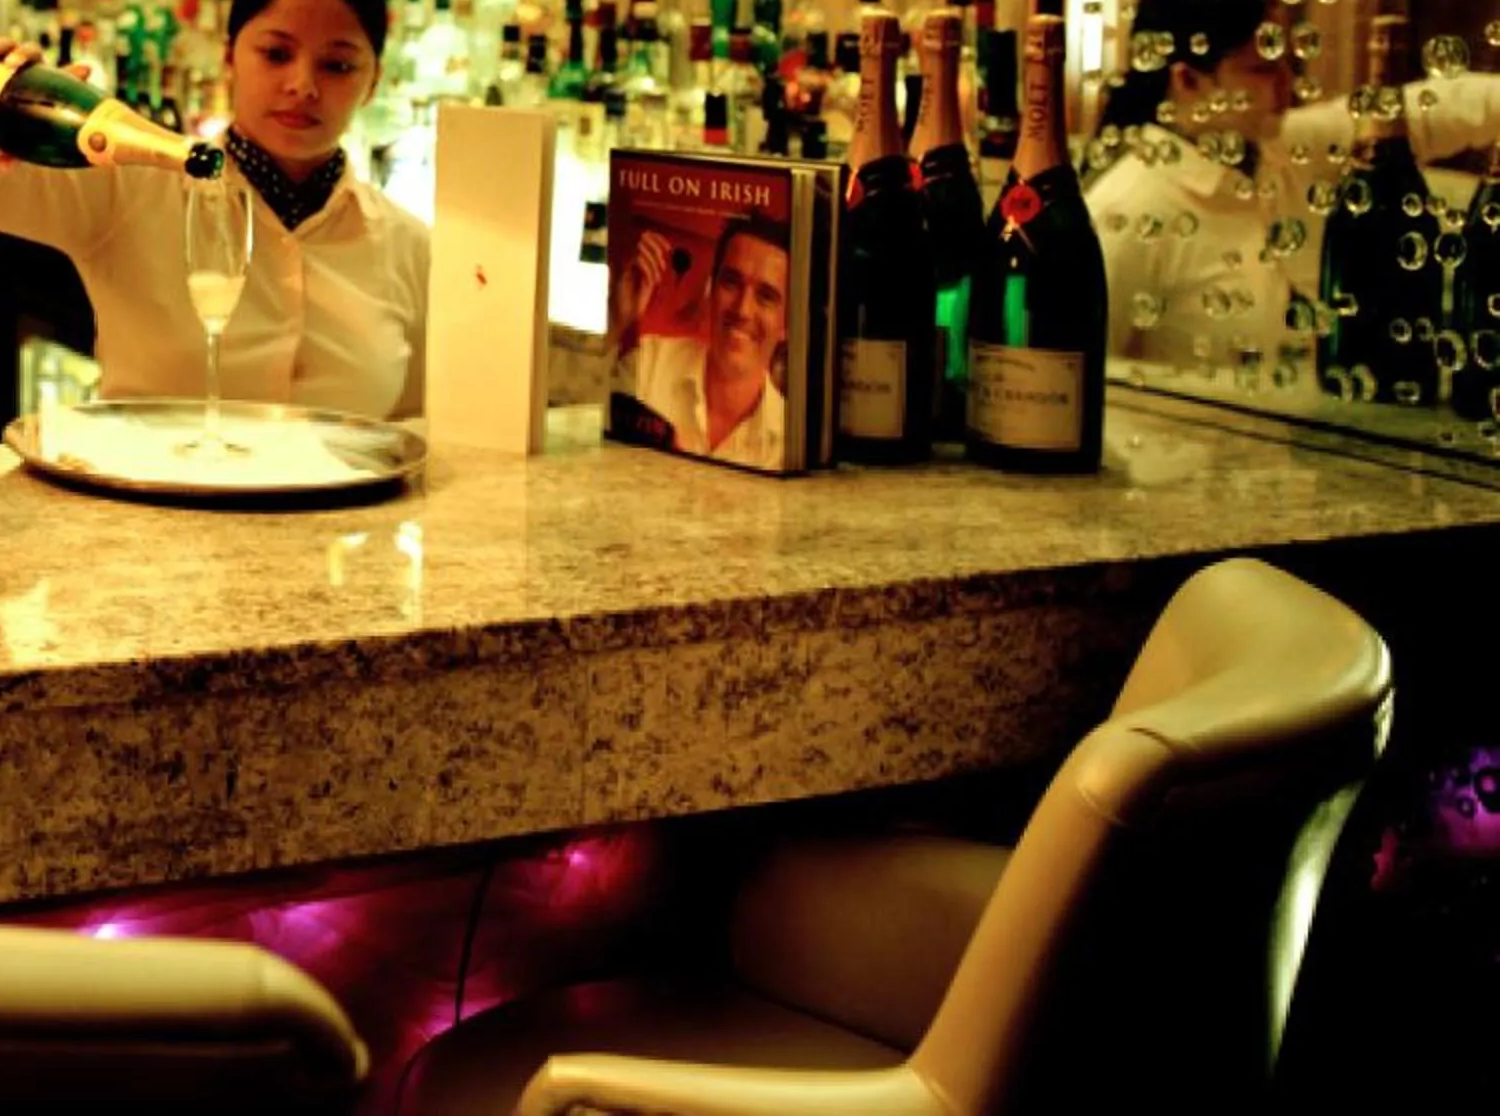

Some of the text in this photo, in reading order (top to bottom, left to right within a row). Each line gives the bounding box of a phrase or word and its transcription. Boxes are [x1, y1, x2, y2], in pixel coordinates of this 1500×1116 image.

[619, 169, 770, 206] FULL ON IRISH
